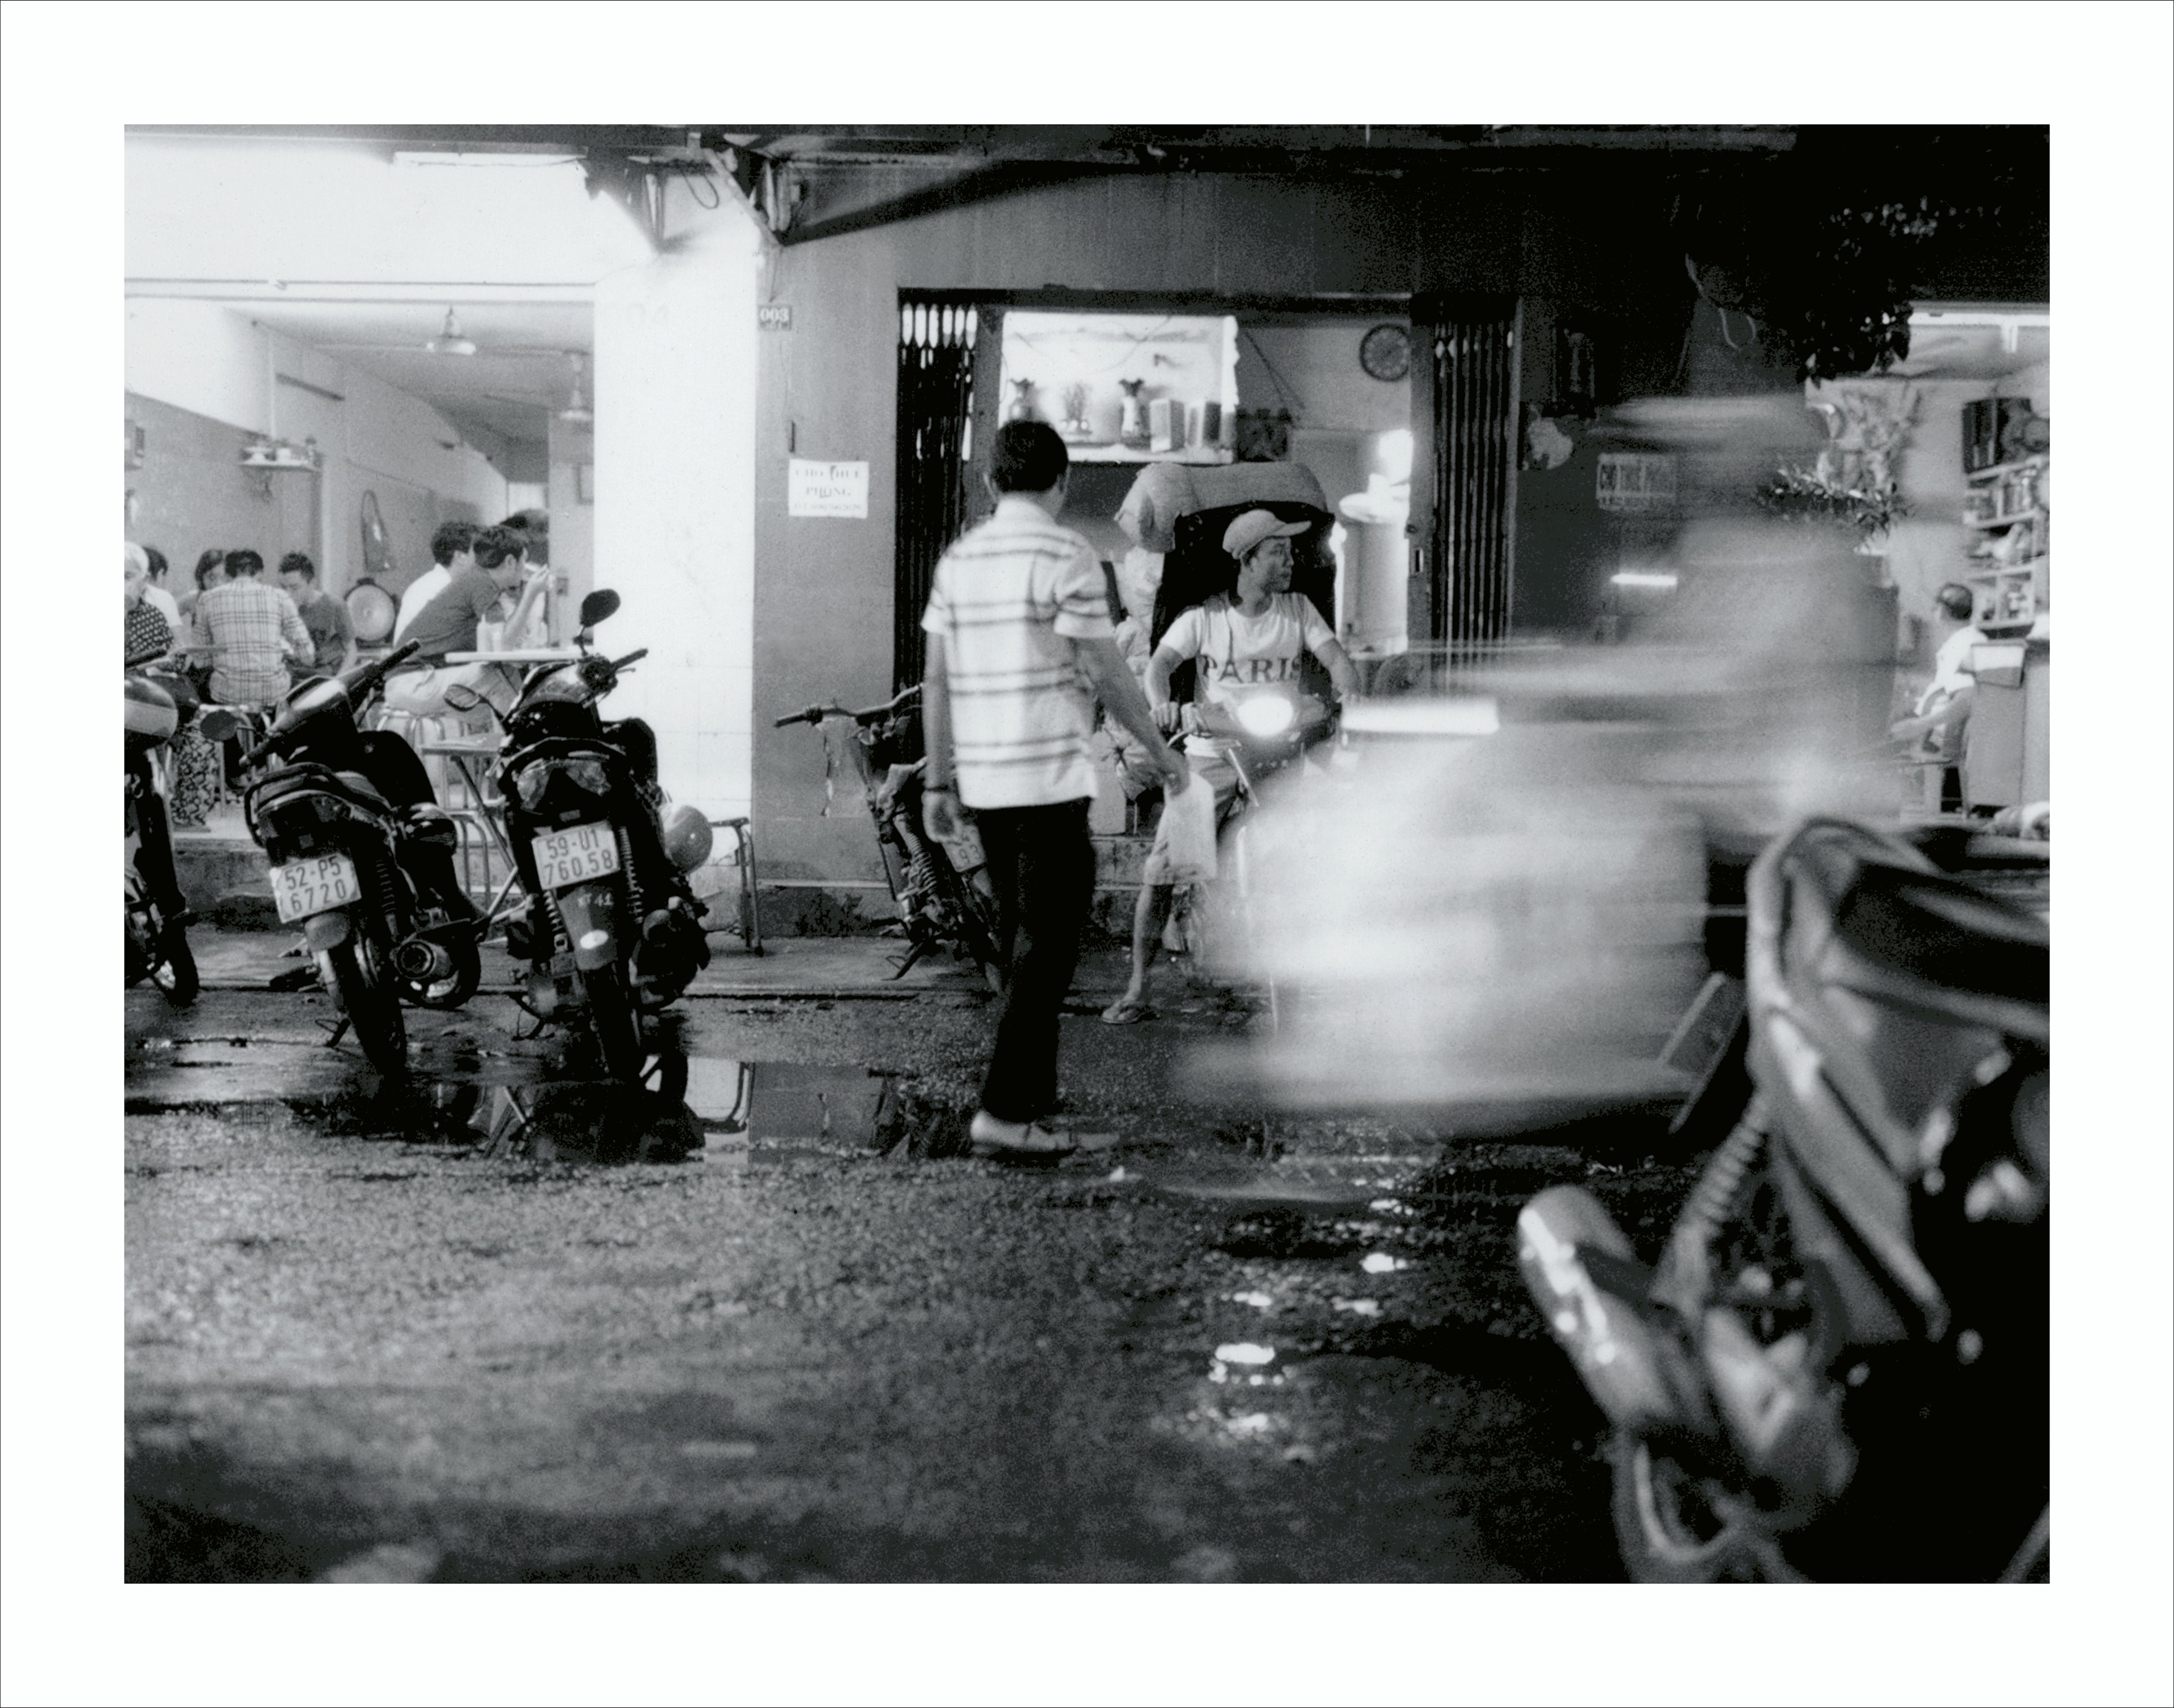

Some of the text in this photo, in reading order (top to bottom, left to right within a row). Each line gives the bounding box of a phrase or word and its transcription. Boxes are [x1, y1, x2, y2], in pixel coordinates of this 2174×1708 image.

[760, 307, 789, 322] 003
[1197, 654, 1302, 684] PARIS
[546, 828, 600, 859] 59-U1
[543, 849, 613, 885] 760.58
[290, 879, 346, 913] 6720
